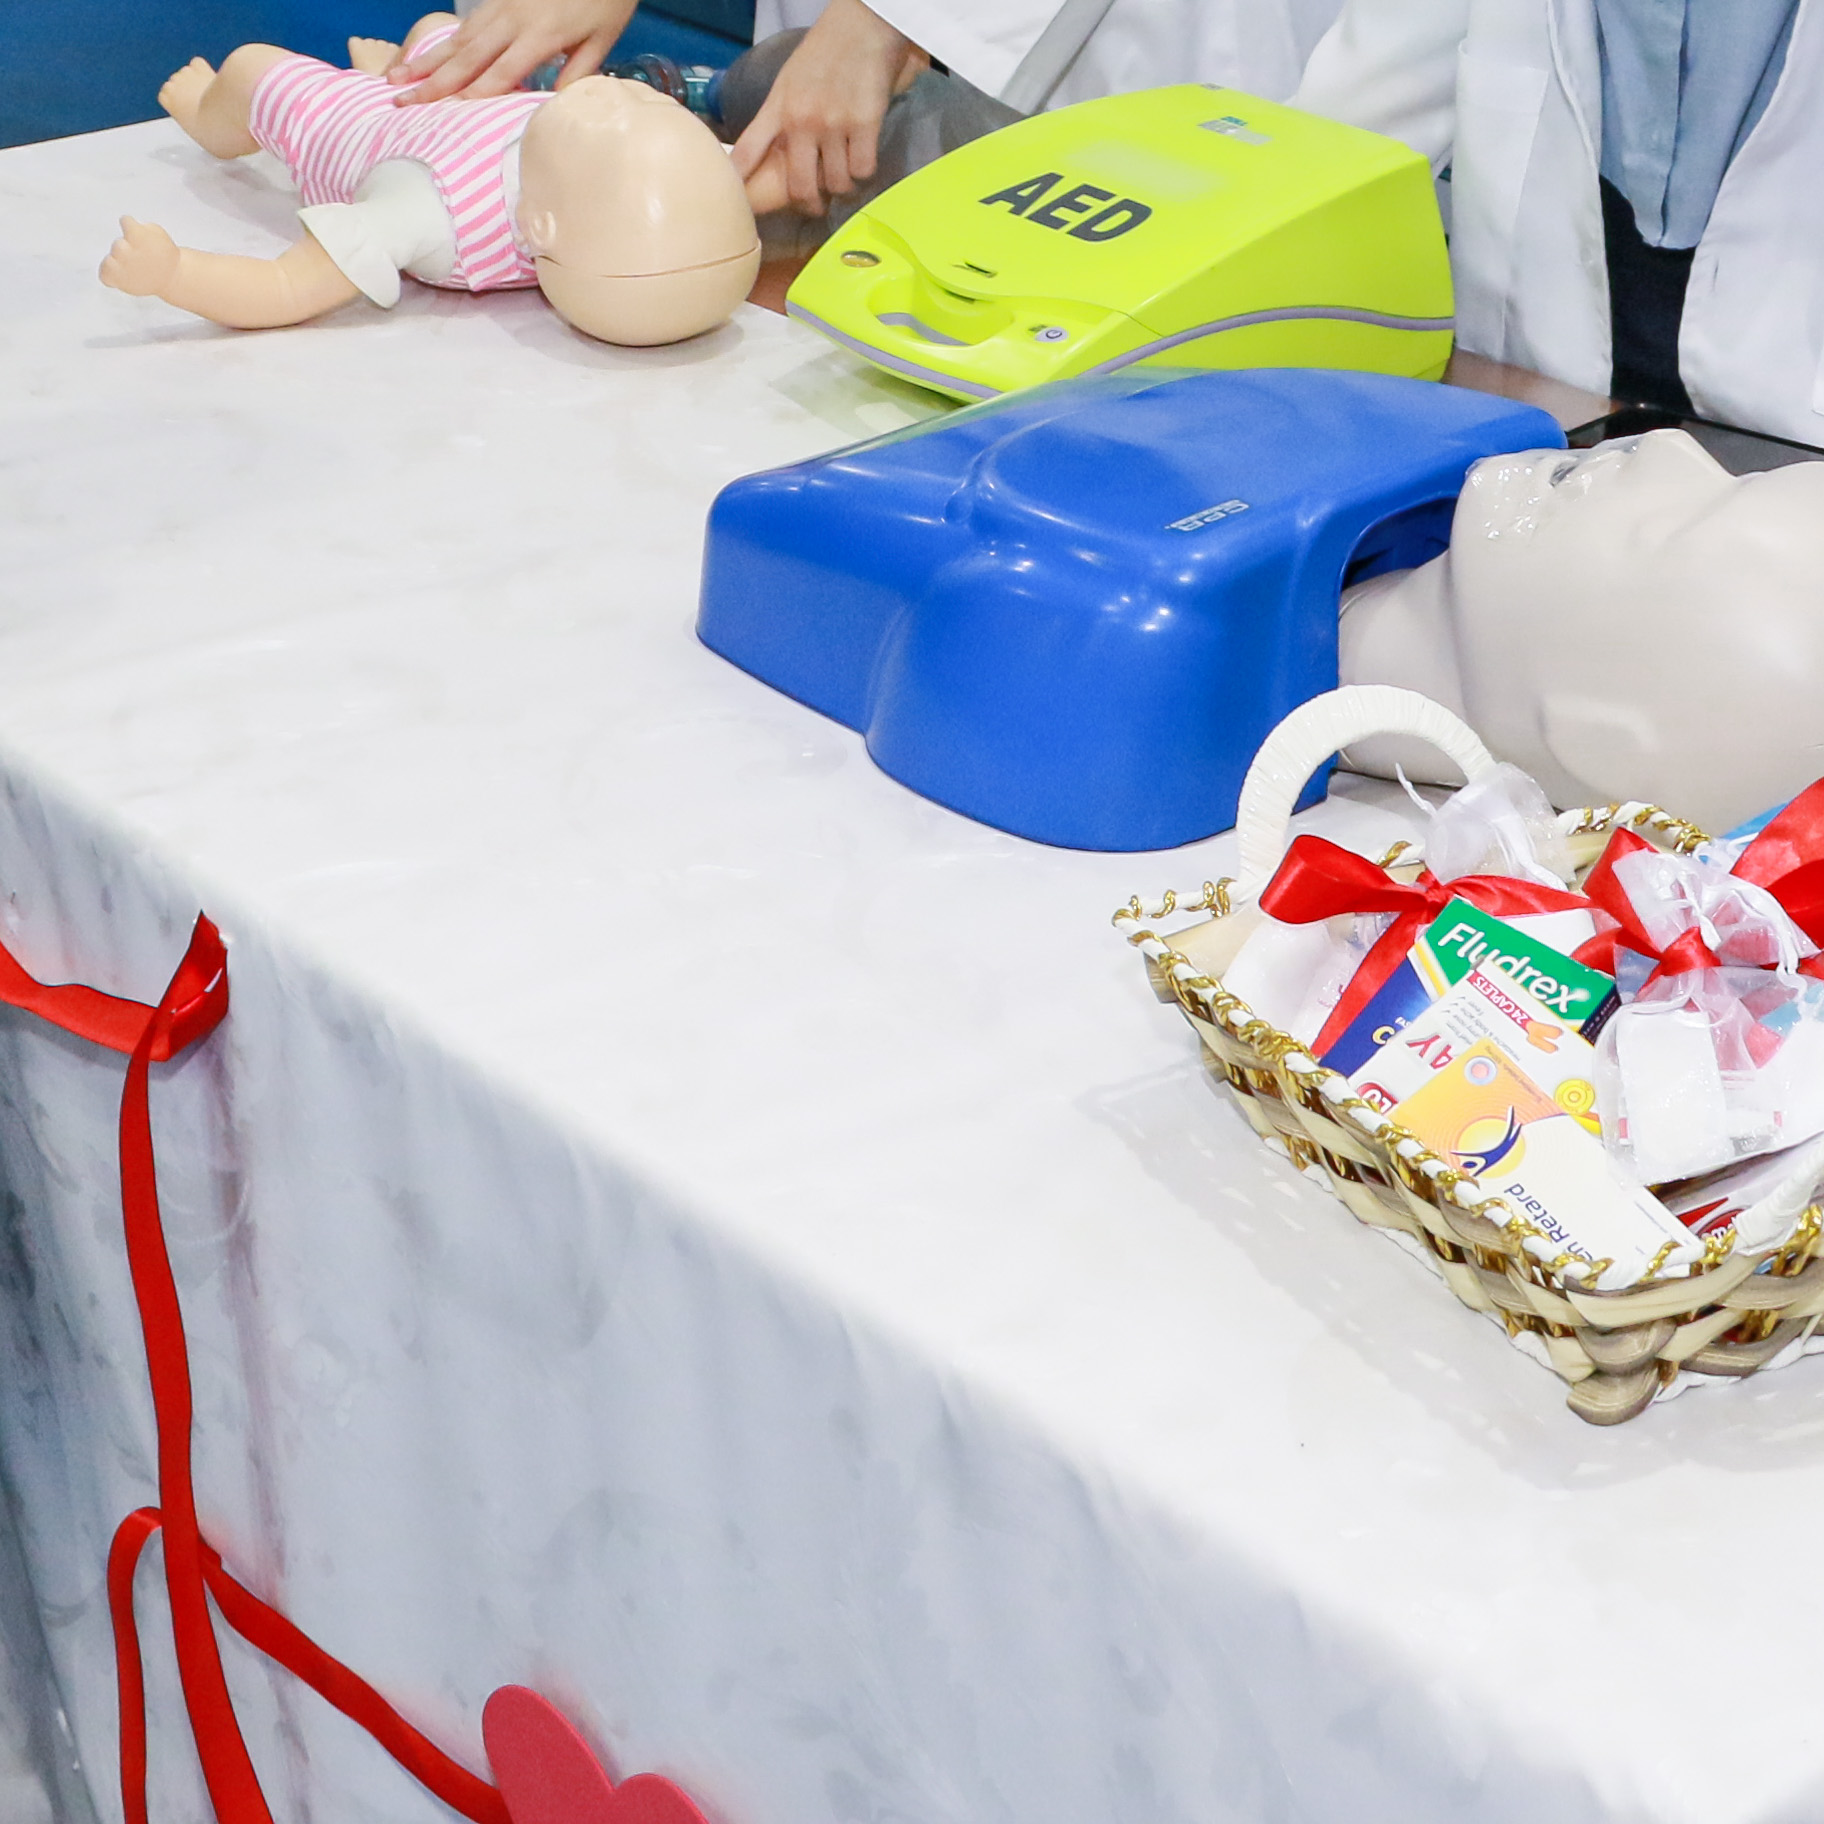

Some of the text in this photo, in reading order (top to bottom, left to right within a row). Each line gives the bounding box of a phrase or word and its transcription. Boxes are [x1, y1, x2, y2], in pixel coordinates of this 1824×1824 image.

[978, 171, 1155, 243] AED
[1437, 922, 1580, 1014] Fludrex
[1473, 976, 1514, 1017] CAPLETS
[1504, 1182, 1570, 1246] Retard
